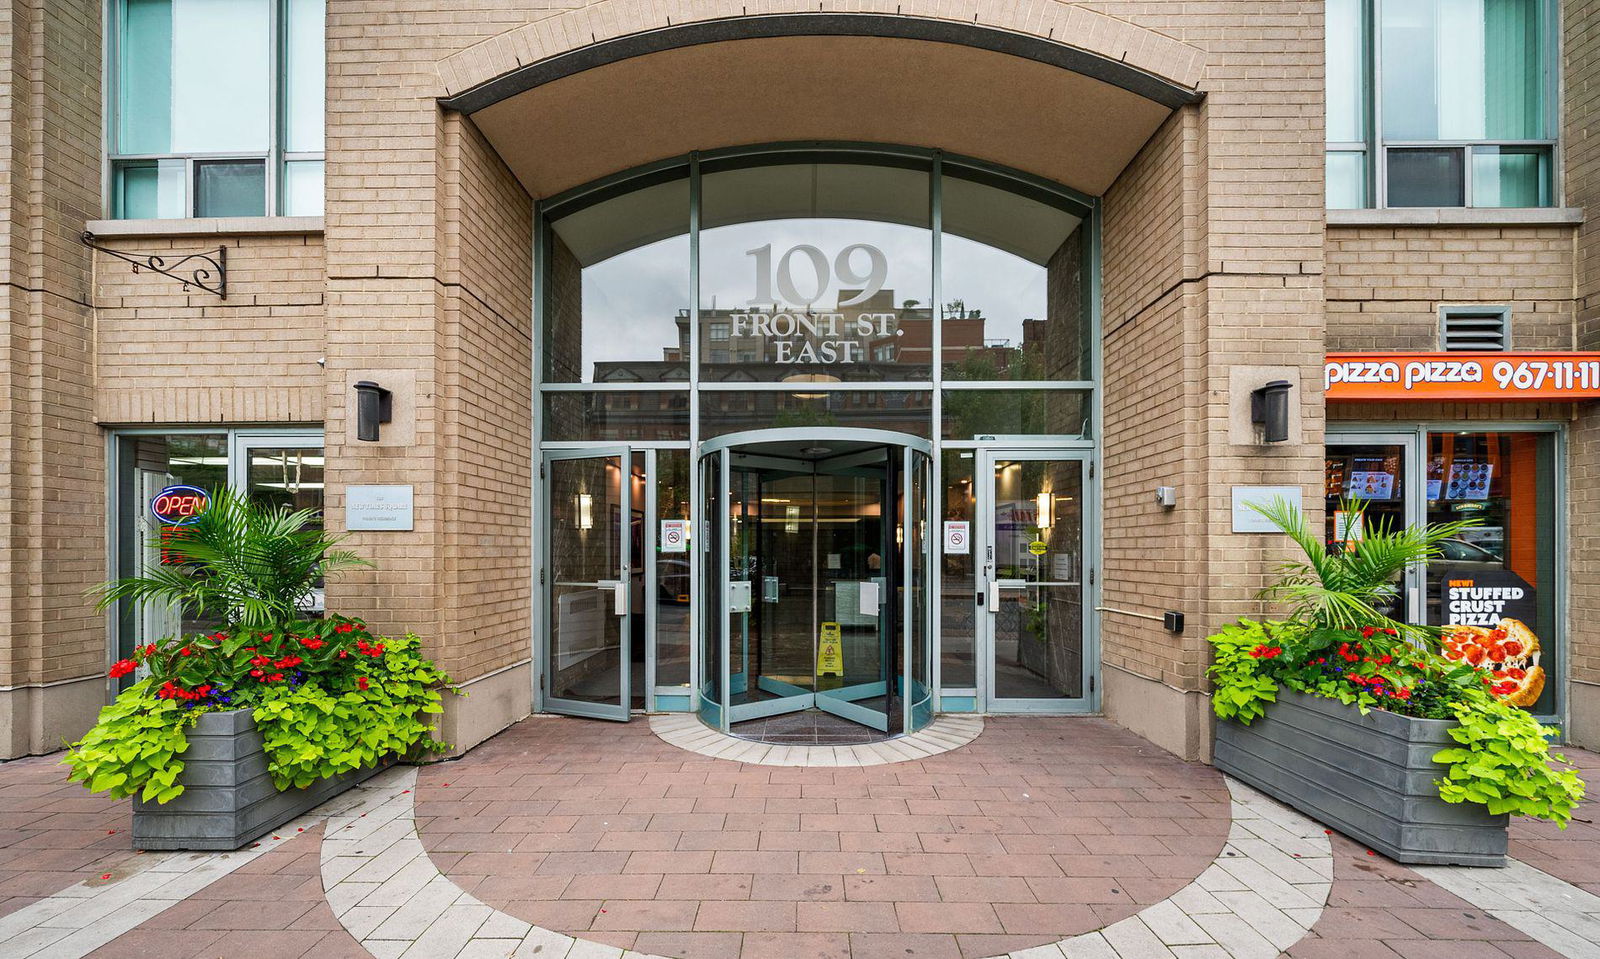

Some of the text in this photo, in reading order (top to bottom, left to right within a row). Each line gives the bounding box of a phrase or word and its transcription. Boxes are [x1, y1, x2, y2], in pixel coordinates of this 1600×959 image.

[745, 243, 888, 307] 109
[729, 313, 904, 337] FRONT ST.
[773, 340, 859, 364] EAST
[1405, 361, 1483, 390] pizza
[155, 495, 207, 516] OPEN
[1448, 587, 1524, 600] STUFFED
[1448, 600, 1506, 613] CRUST
[1448, 613, 1502, 626] PIZZA
